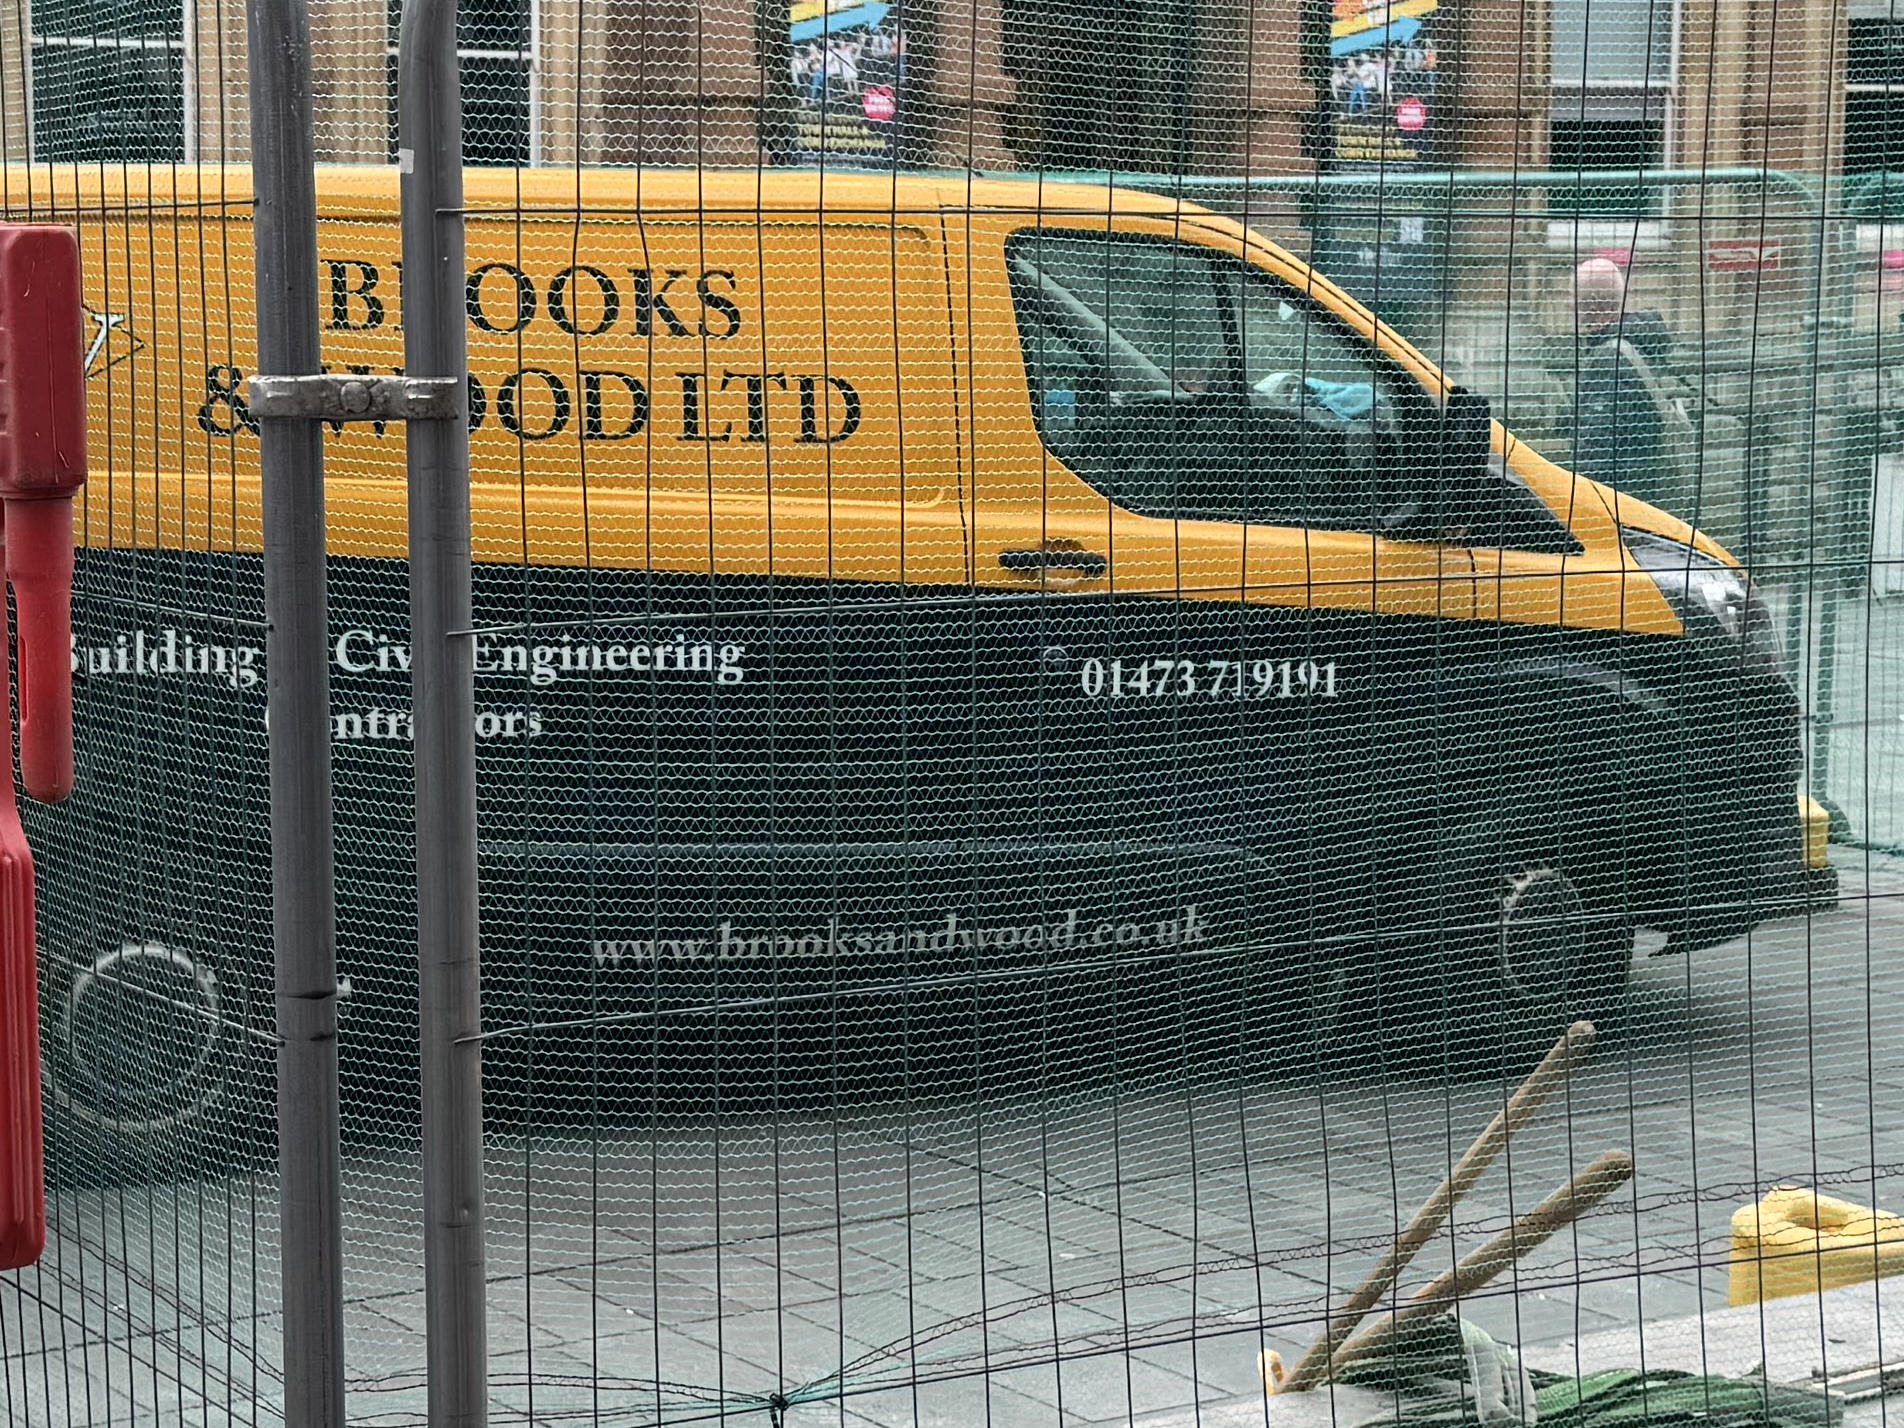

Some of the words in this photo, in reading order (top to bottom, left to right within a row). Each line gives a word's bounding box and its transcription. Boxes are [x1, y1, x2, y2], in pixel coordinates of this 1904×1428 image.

[320, 258, 742, 340] BOOKS
[673, 371, 863, 445] LTD
[71, 629, 260, 688] uilding
[471, 627, 746, 687] Engineering
[1080, 657, 1196, 698] 01473
